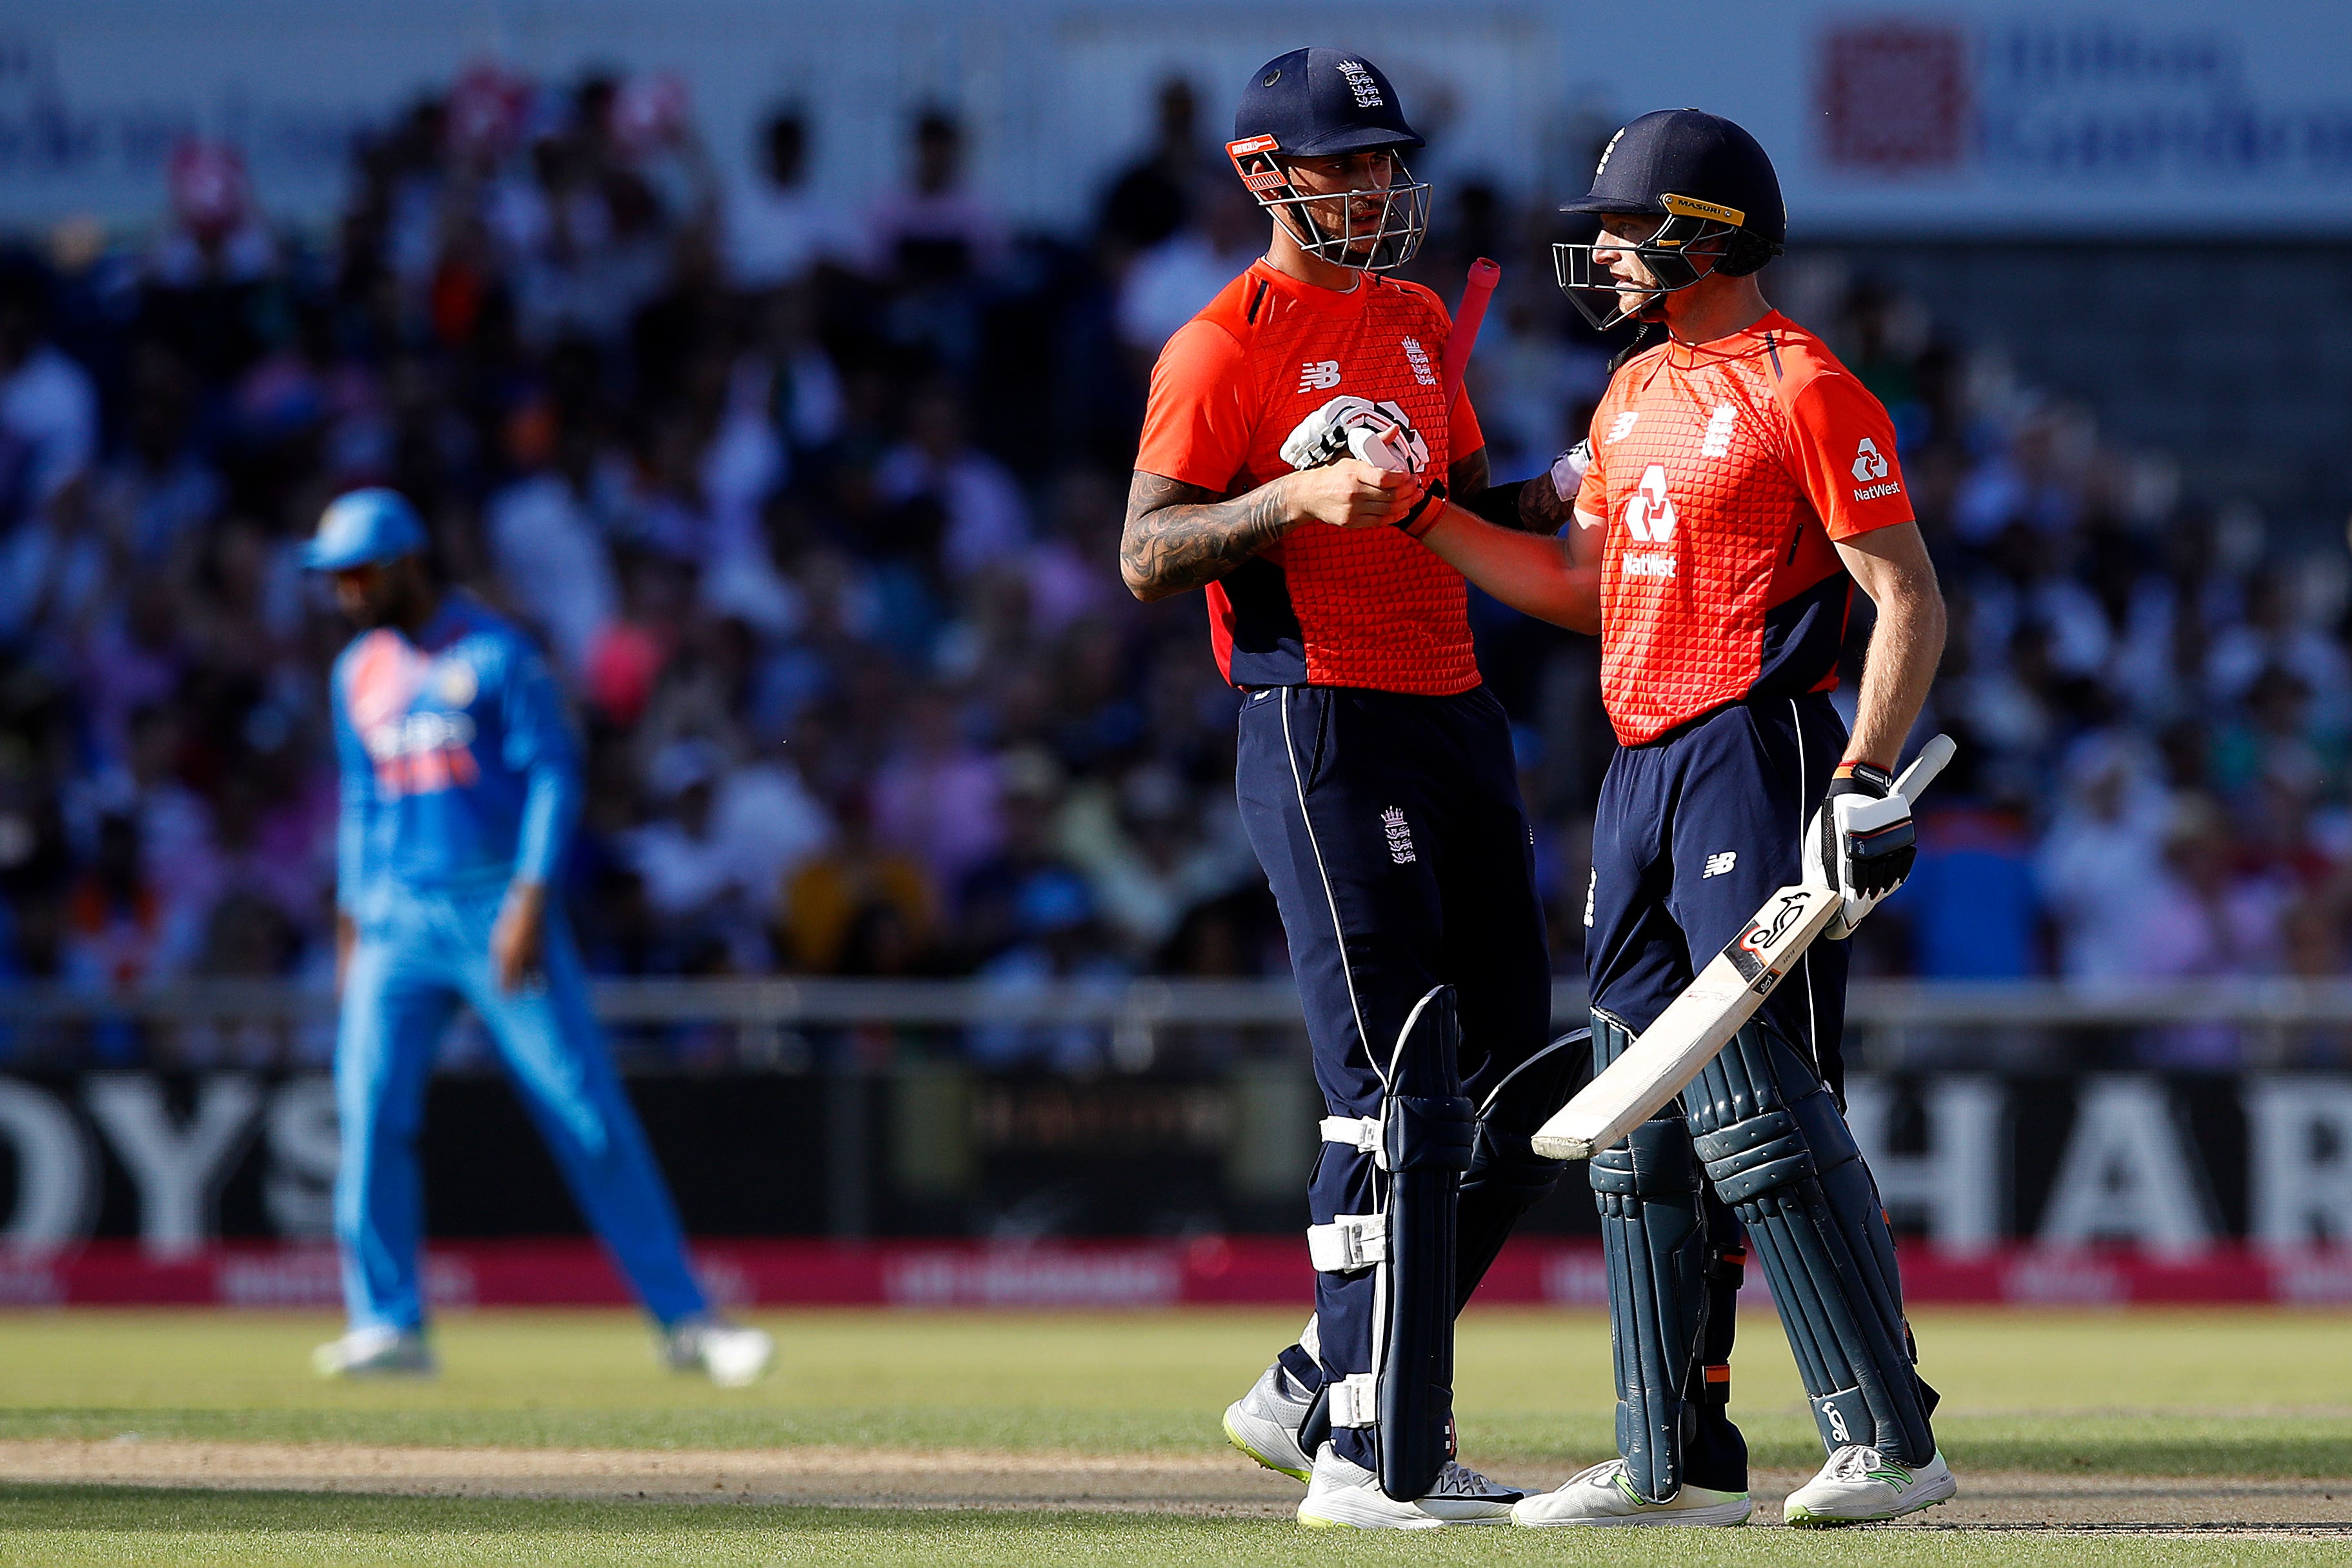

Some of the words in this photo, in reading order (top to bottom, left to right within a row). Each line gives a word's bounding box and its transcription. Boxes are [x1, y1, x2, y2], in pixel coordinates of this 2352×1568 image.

[1678, 199, 1721, 214] MASURI
[1853, 481, 1900, 502] NatWest
[1622, 552, 1677, 578] NatWest
